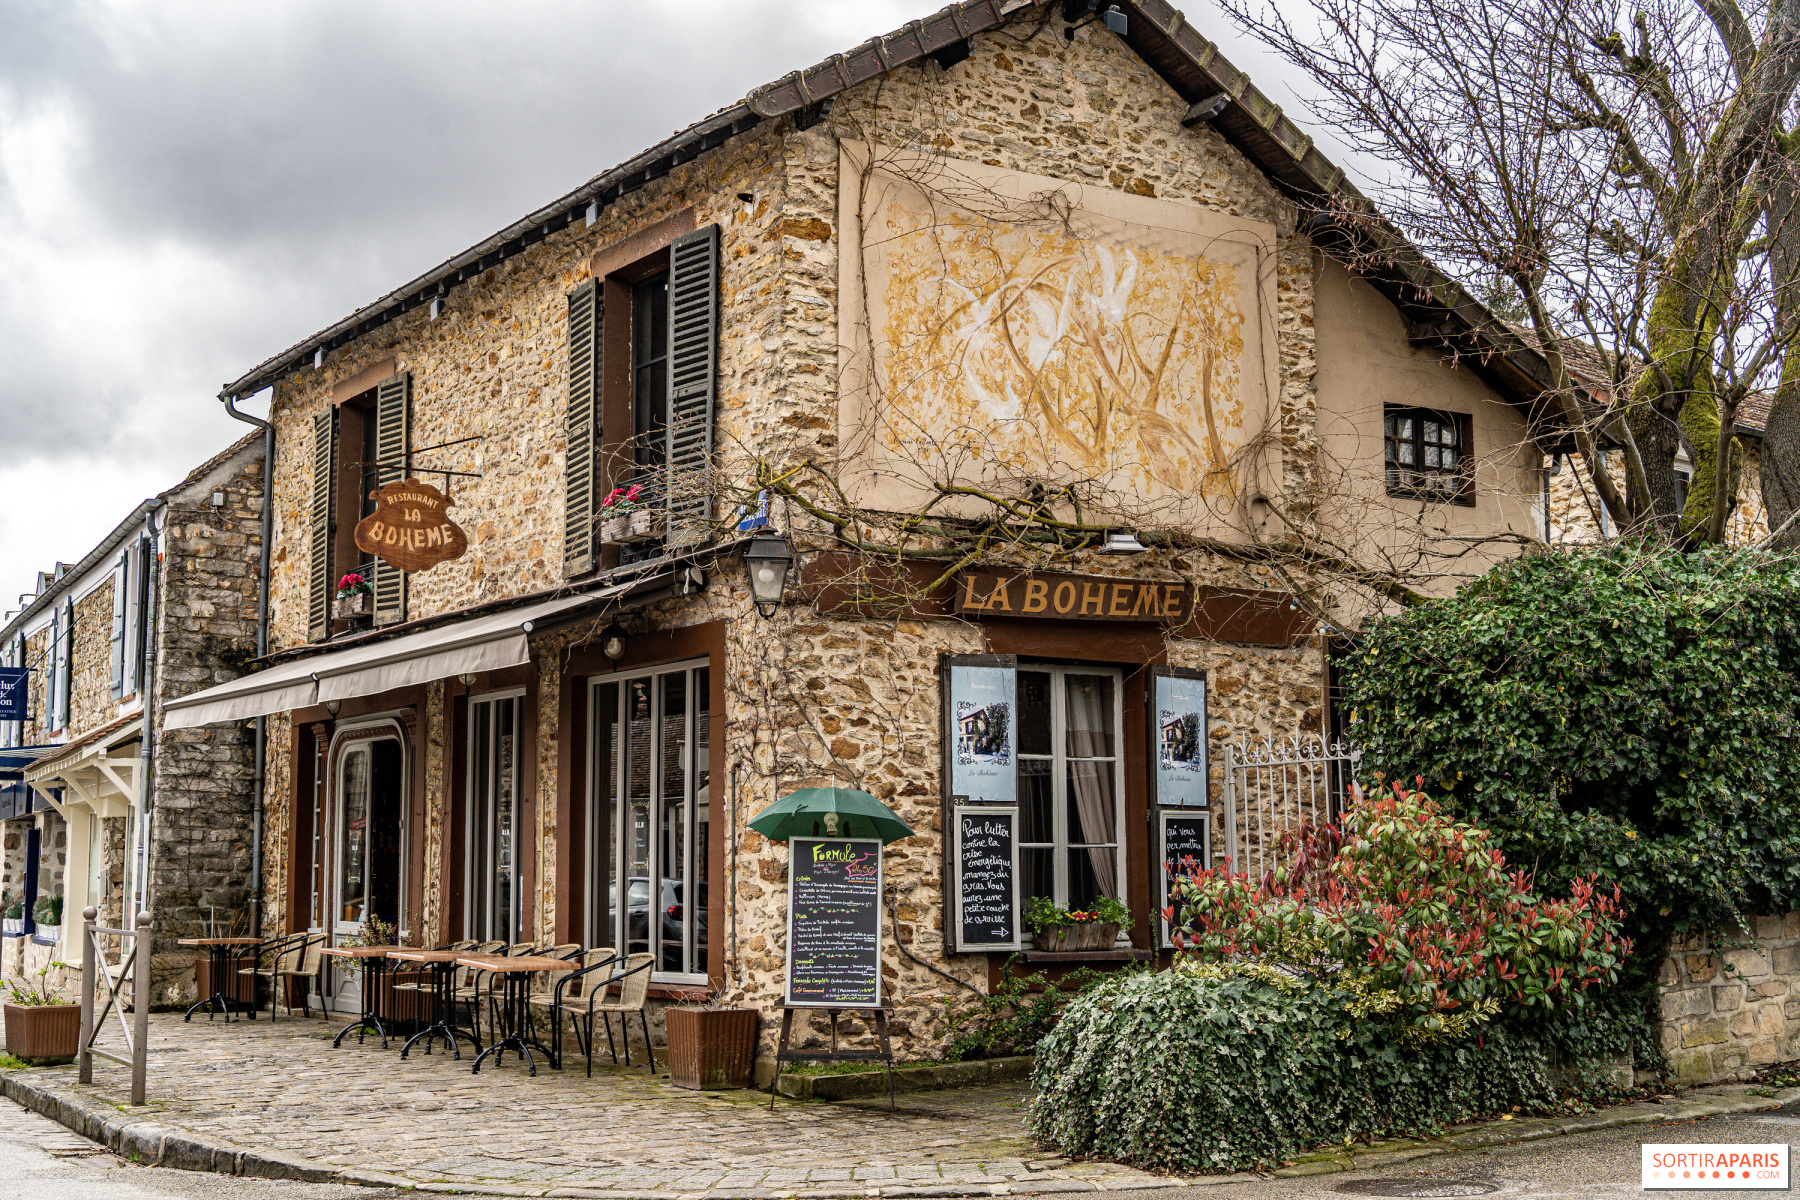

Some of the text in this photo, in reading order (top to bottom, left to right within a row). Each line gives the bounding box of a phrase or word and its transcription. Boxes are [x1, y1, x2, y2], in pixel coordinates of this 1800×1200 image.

[387, 493, 439, 509] RESTAURANT
[405, 508, 421, 522] LA
[368, 520, 454, 552] BOHEME
[962, 575, 1185, 617] LA BOHEME
[962, 818, 1010, 838] Pour lutter
[1166, 825, 1196, 840] qui vous
[962, 837, 1000, 849] contre la
[963, 849, 983, 860] crise
[963, 869, 1009, 881] mangez du
[987, 879, 1005, 890] Vous
[963, 895, 983, 903] aurez
[964, 903, 1010, 916] petite couche
[964, 914, 1005, 924] de graisse
